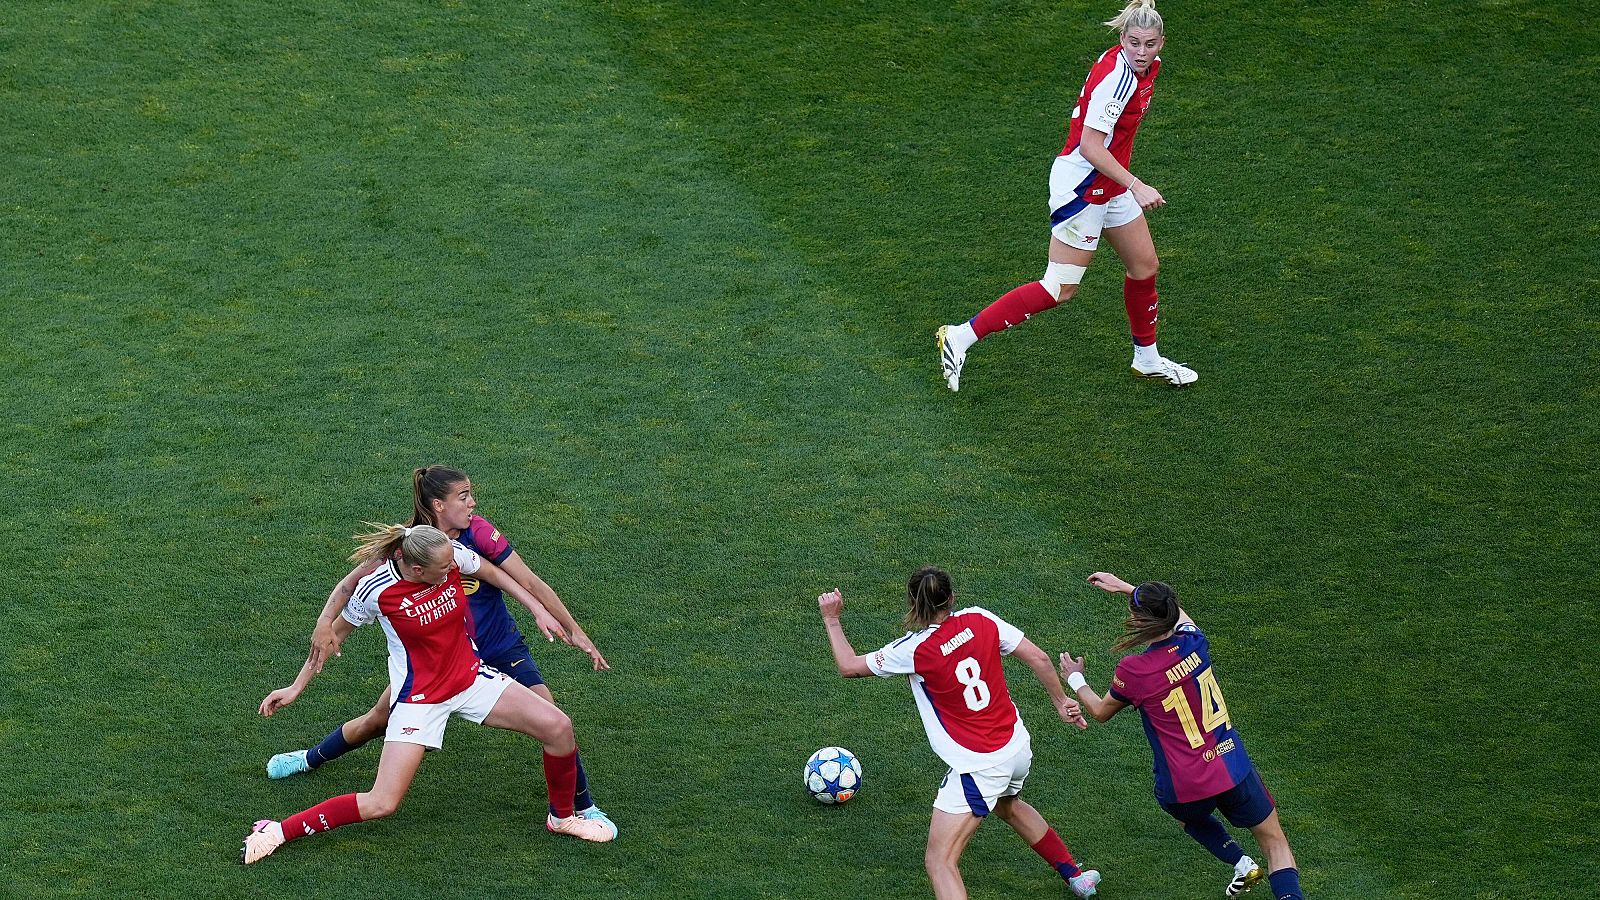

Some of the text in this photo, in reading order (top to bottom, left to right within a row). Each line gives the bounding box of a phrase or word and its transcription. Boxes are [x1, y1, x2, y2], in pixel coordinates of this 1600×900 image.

[419, 598, 458, 627] FLY BETTER
[955, 656, 991, 712] 8
[1165, 651, 1203, 685] AITANA
[1161, 665, 1232, 750] 14
